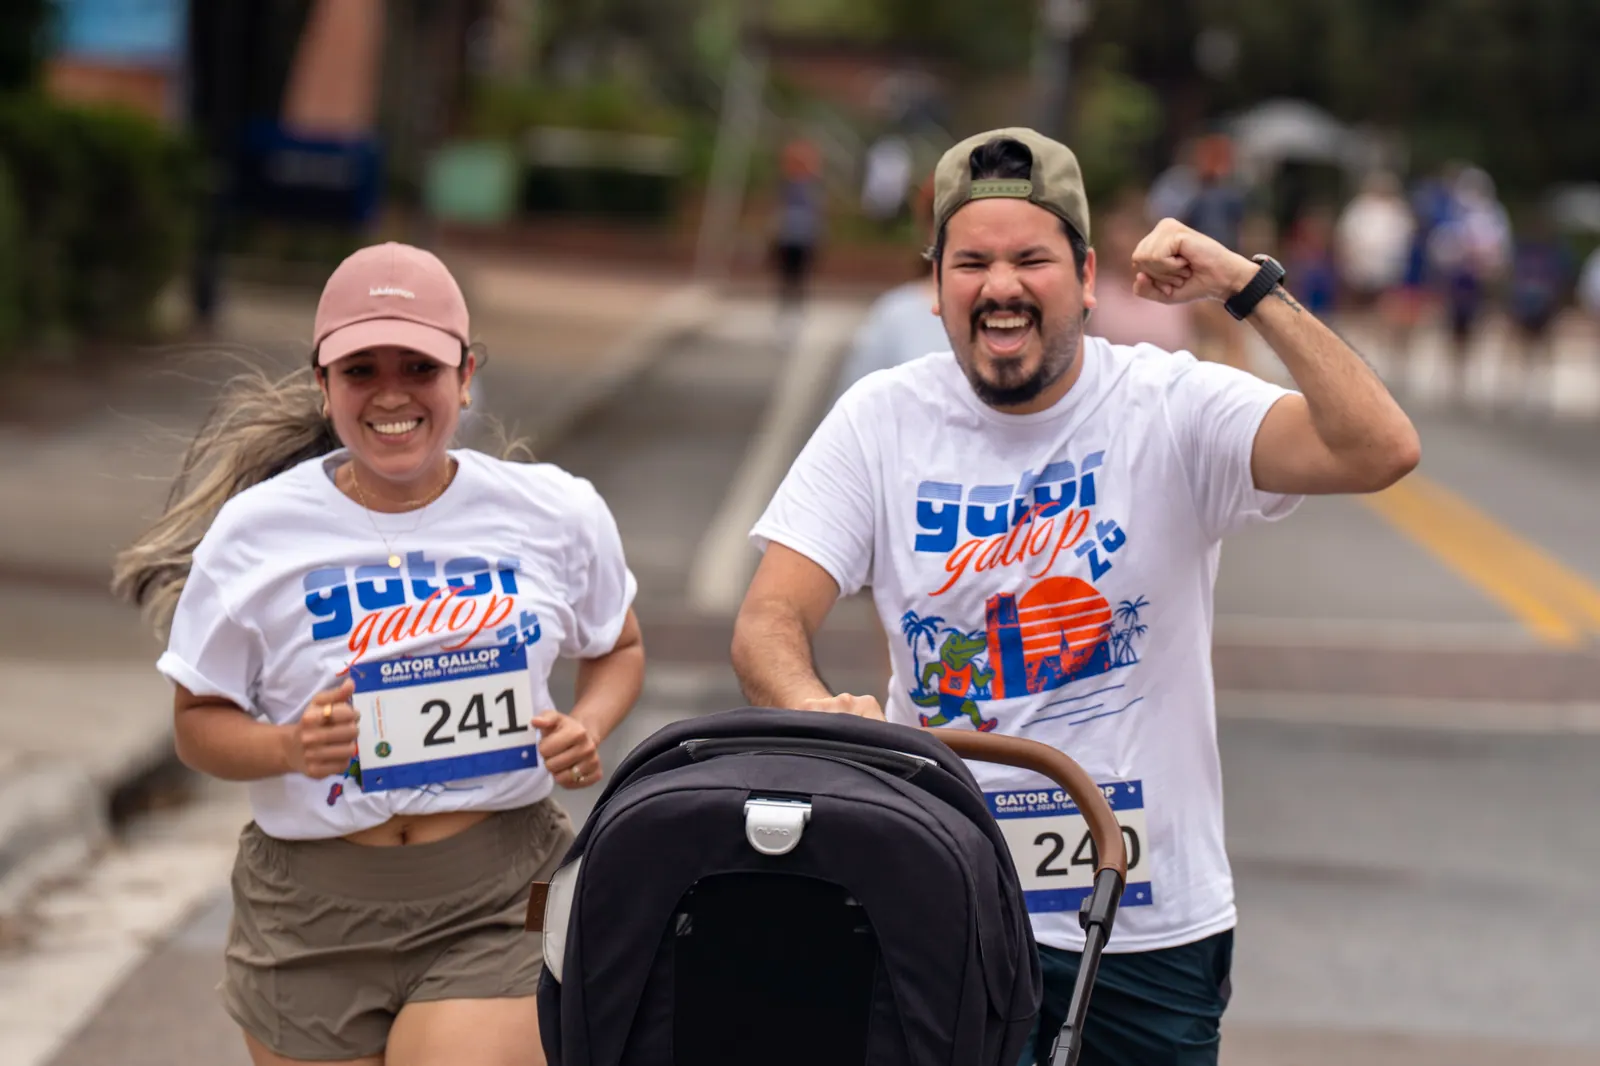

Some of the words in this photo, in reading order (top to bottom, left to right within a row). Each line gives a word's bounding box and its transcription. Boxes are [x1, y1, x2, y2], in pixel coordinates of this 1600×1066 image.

[914, 450, 1106, 553] gator
[928, 501, 1090, 597] gallop
[1074, 519, 1127, 582] 26
[303, 550, 521, 641] gator
[336, 585, 514, 677] gallop
[380, 657, 434, 676] GATOR
[438, 648, 500, 668] GALLOP
[420, 688, 528, 747] 241
[995, 792, 1049, 806] GATOR
